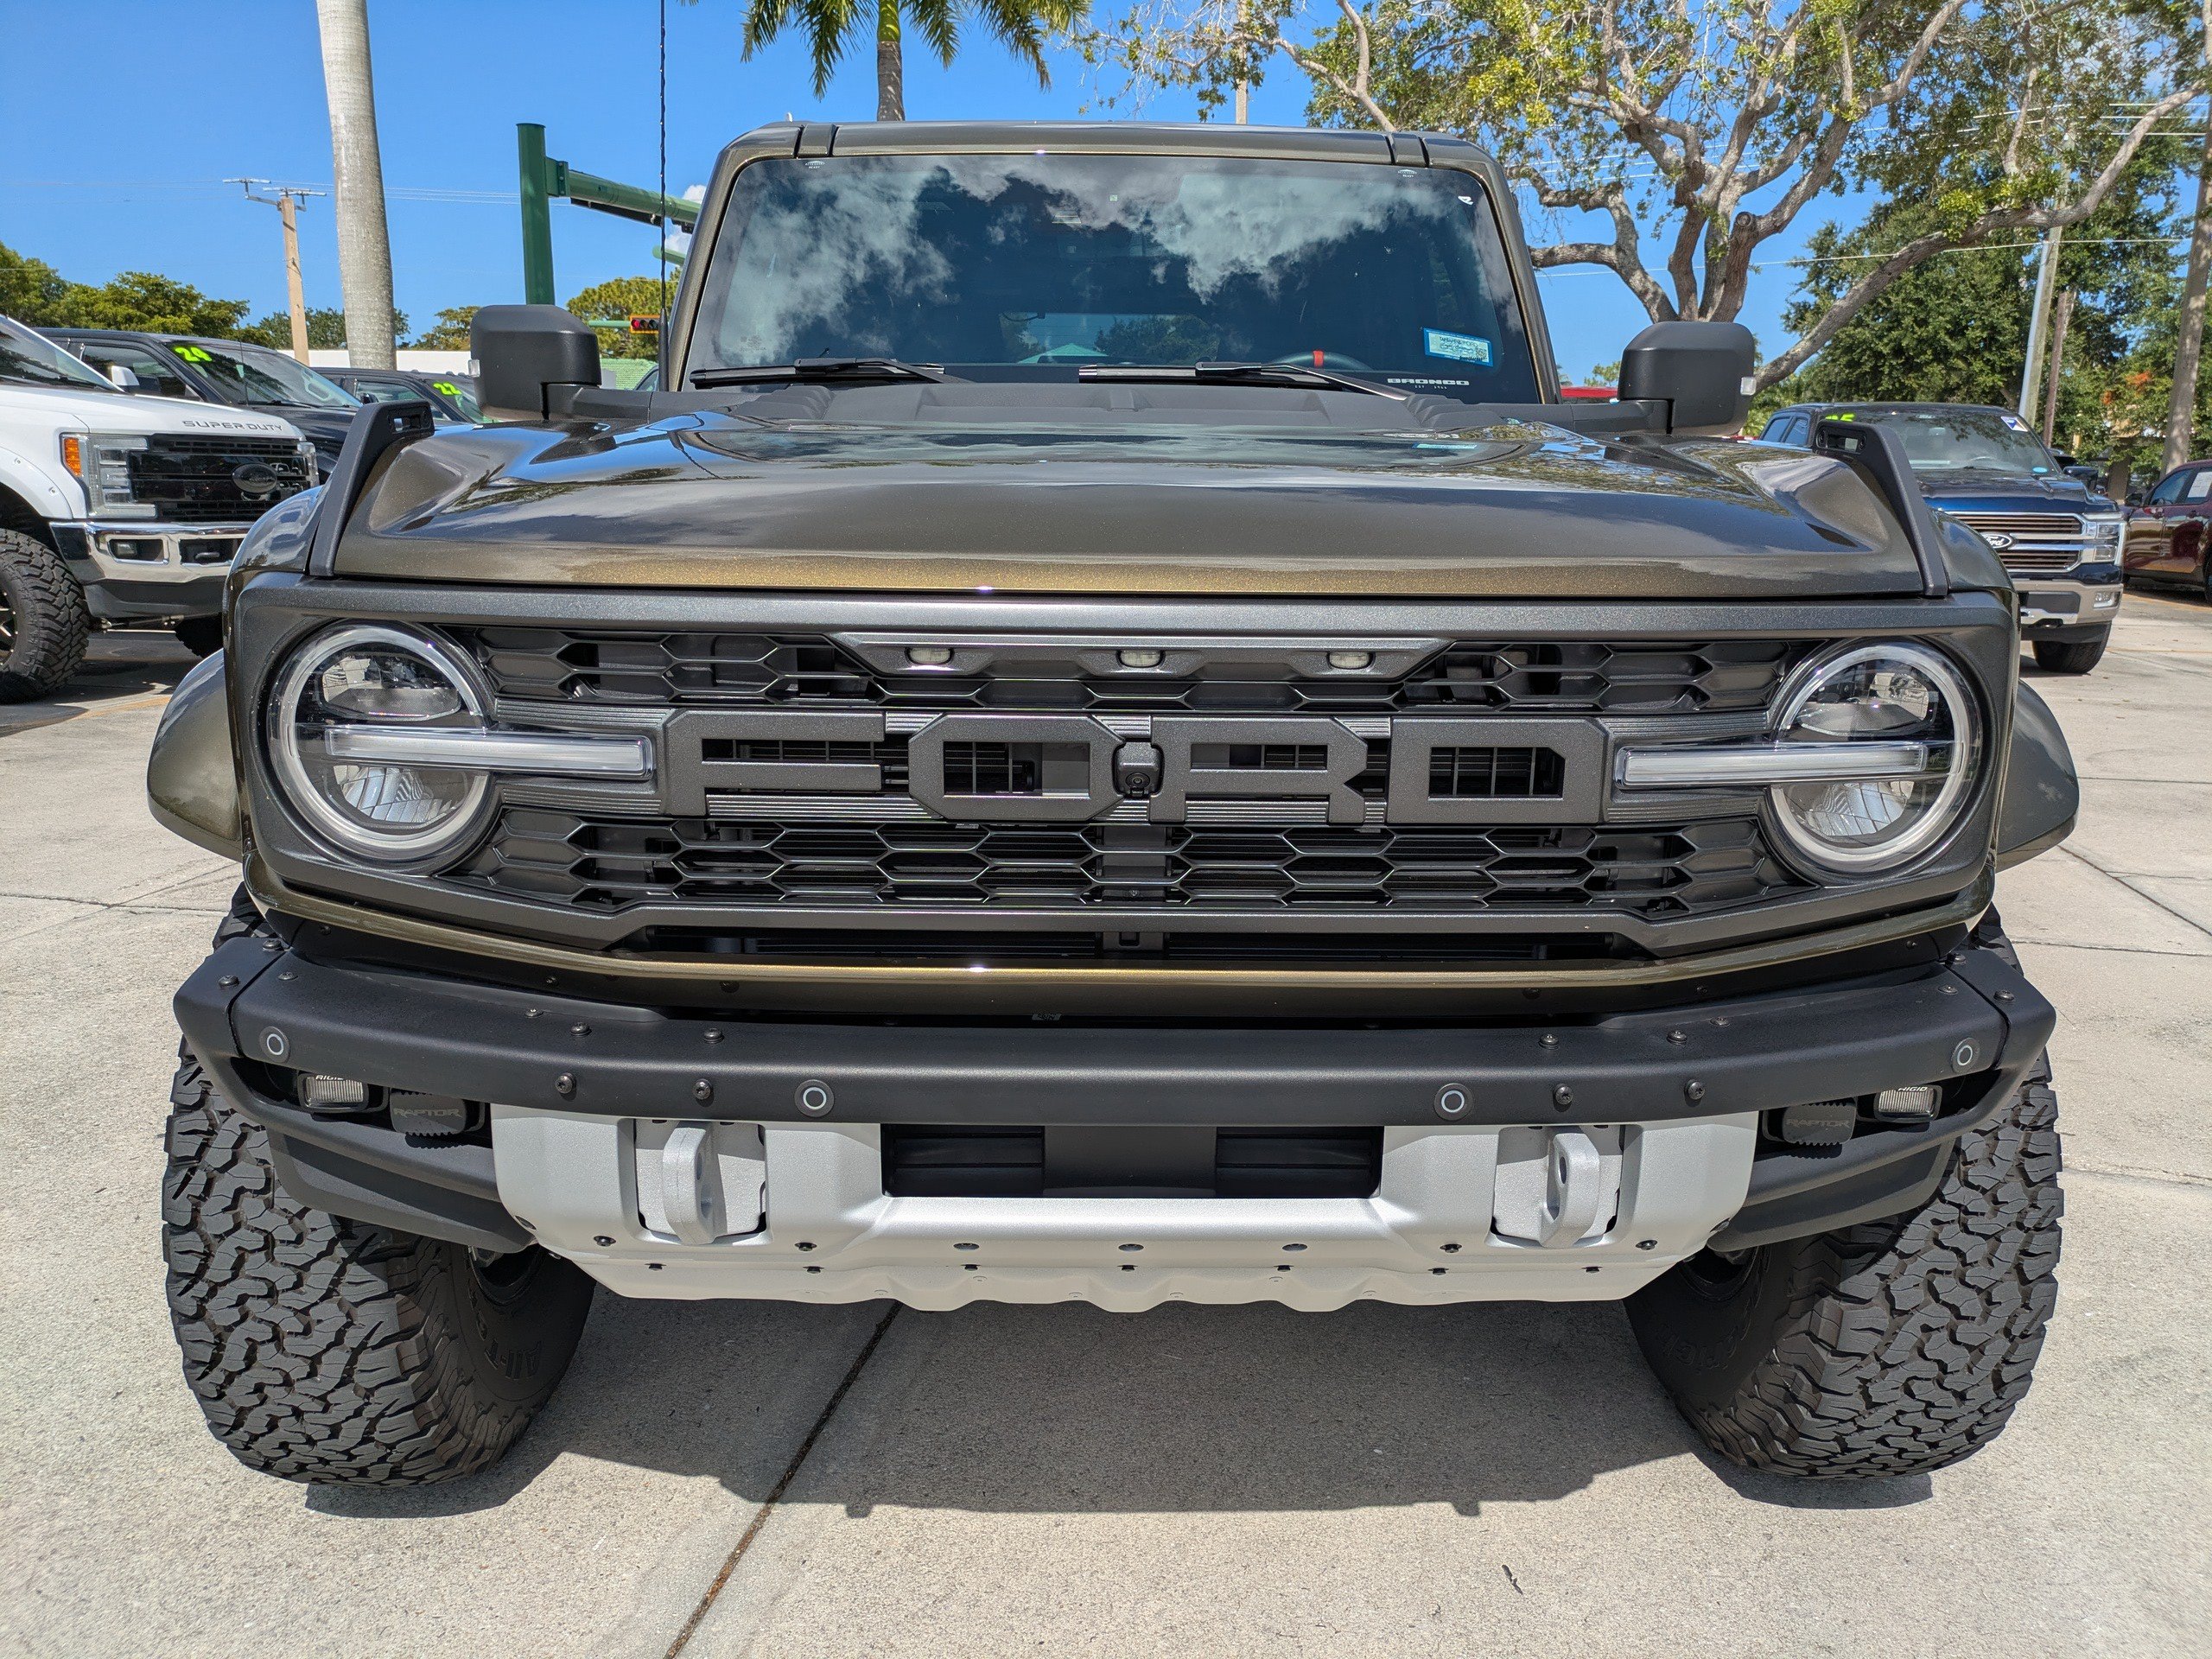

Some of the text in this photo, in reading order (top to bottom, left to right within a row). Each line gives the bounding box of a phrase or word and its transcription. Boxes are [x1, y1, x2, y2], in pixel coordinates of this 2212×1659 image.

[175, 346, 213, 362] 24
[433, 383, 462, 395] 22
[181, 420, 245, 429] SUPER
[665, 709, 1603, 824] FORD
[393, 1108, 463, 1119] RAPTOR
[1786, 1118, 1850, 1128] RAPTOR
